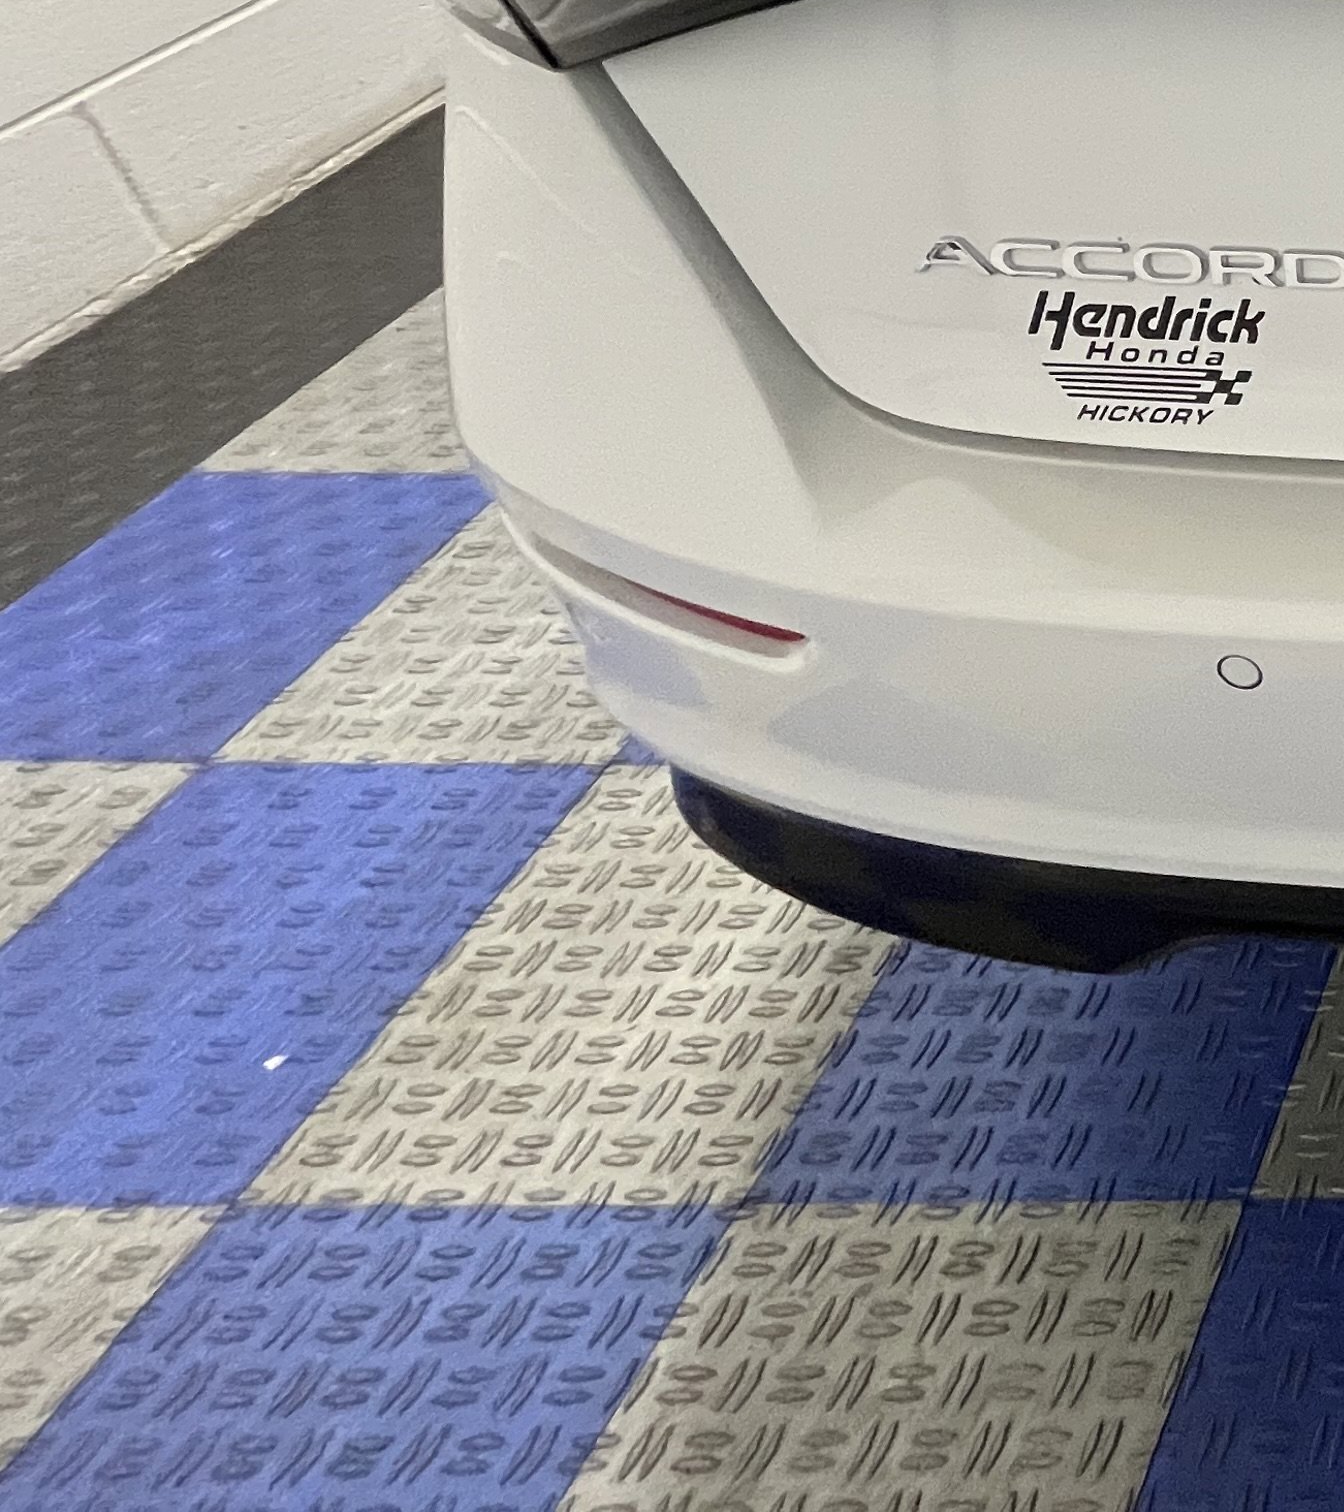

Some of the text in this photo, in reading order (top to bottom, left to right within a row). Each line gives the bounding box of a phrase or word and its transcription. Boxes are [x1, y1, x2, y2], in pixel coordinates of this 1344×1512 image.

[1027, 290, 1266, 350] Hendrick
[1085, 341, 1225, 367] Honda
[1076, 404, 1215, 426] HICKORY
